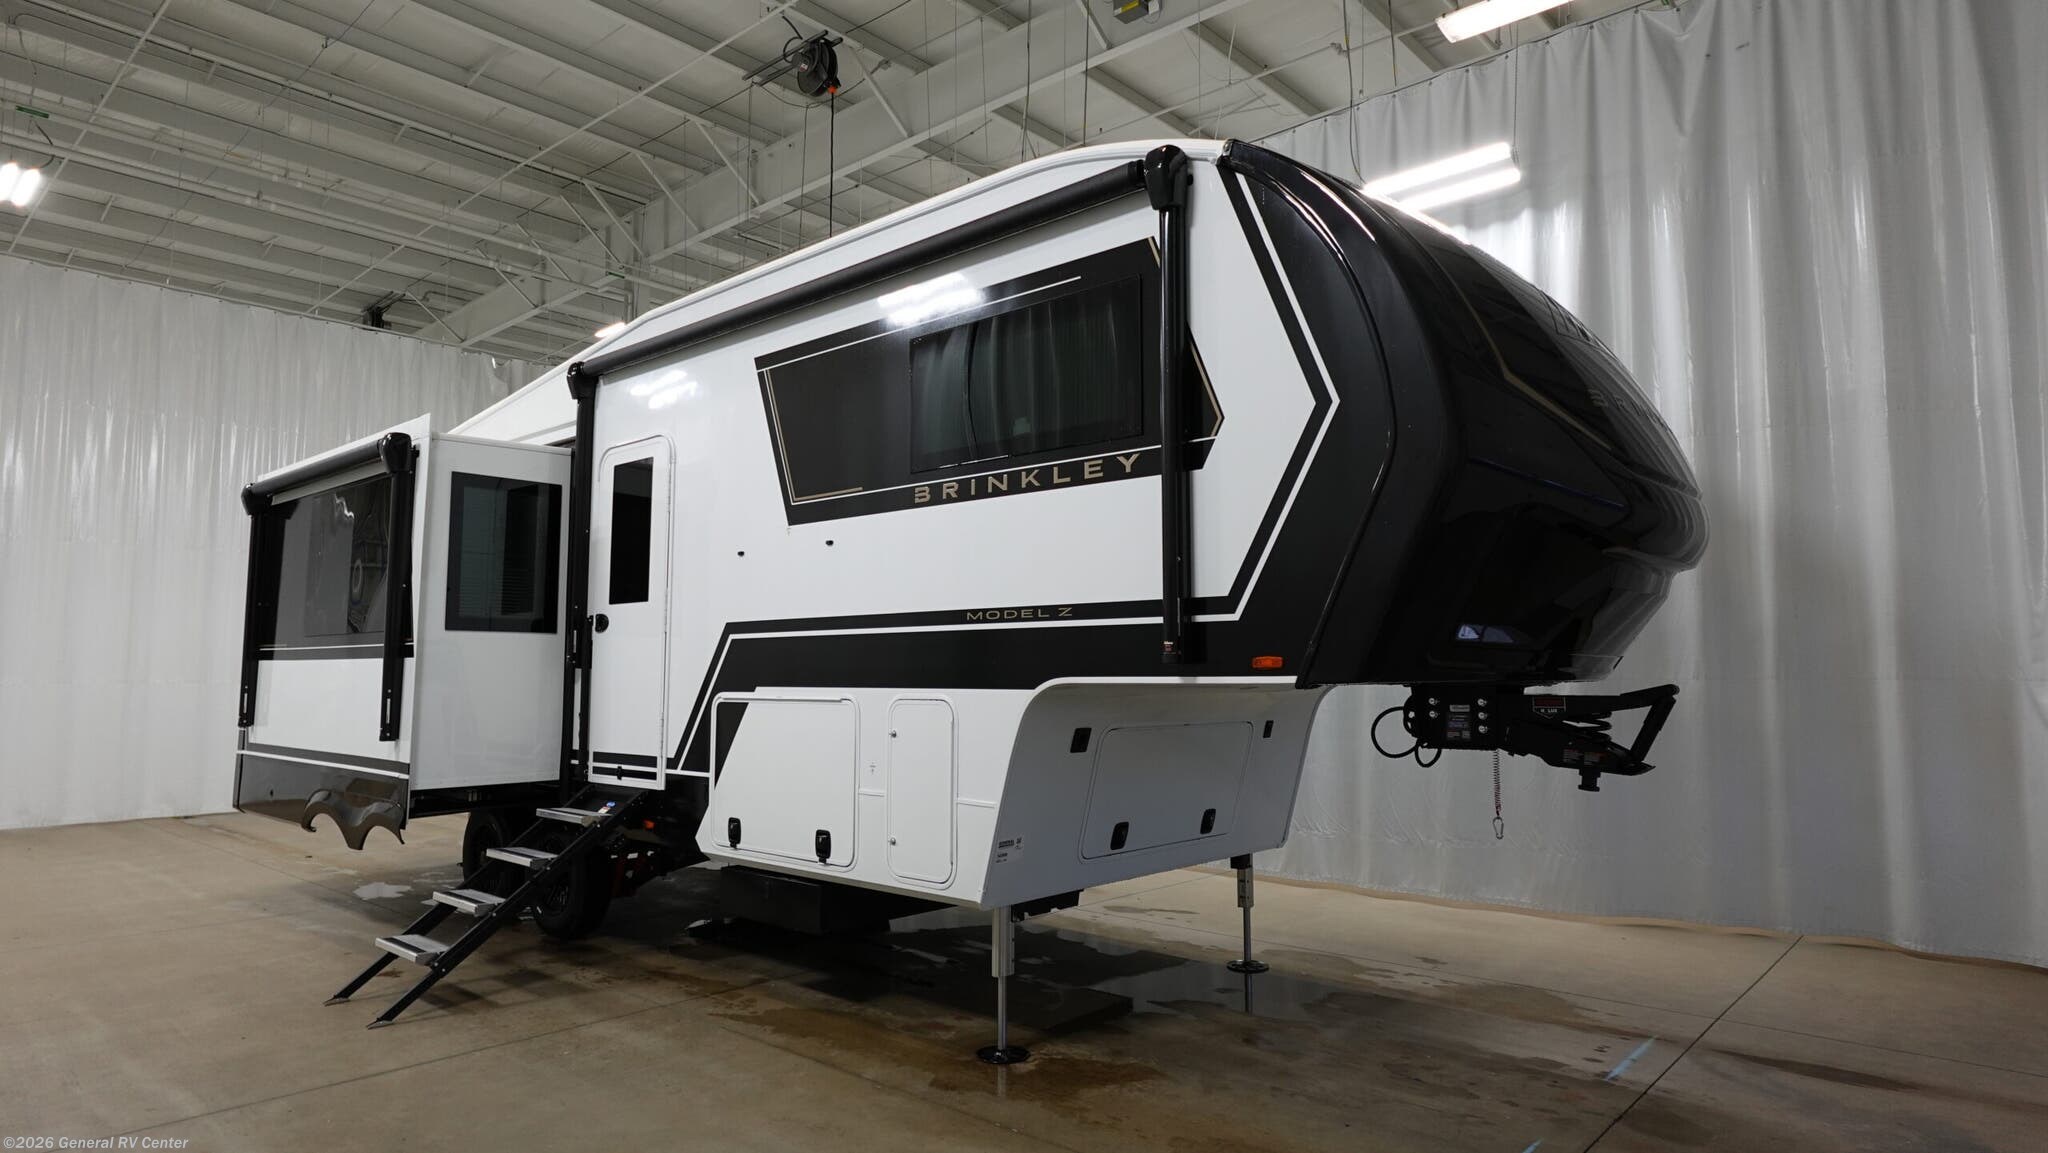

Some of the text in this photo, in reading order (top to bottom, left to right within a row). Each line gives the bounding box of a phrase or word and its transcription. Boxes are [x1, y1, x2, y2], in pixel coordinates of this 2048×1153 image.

[914, 453, 1141, 504] BRINKLEY
[966, 607, 1073, 621] MODEL Z
